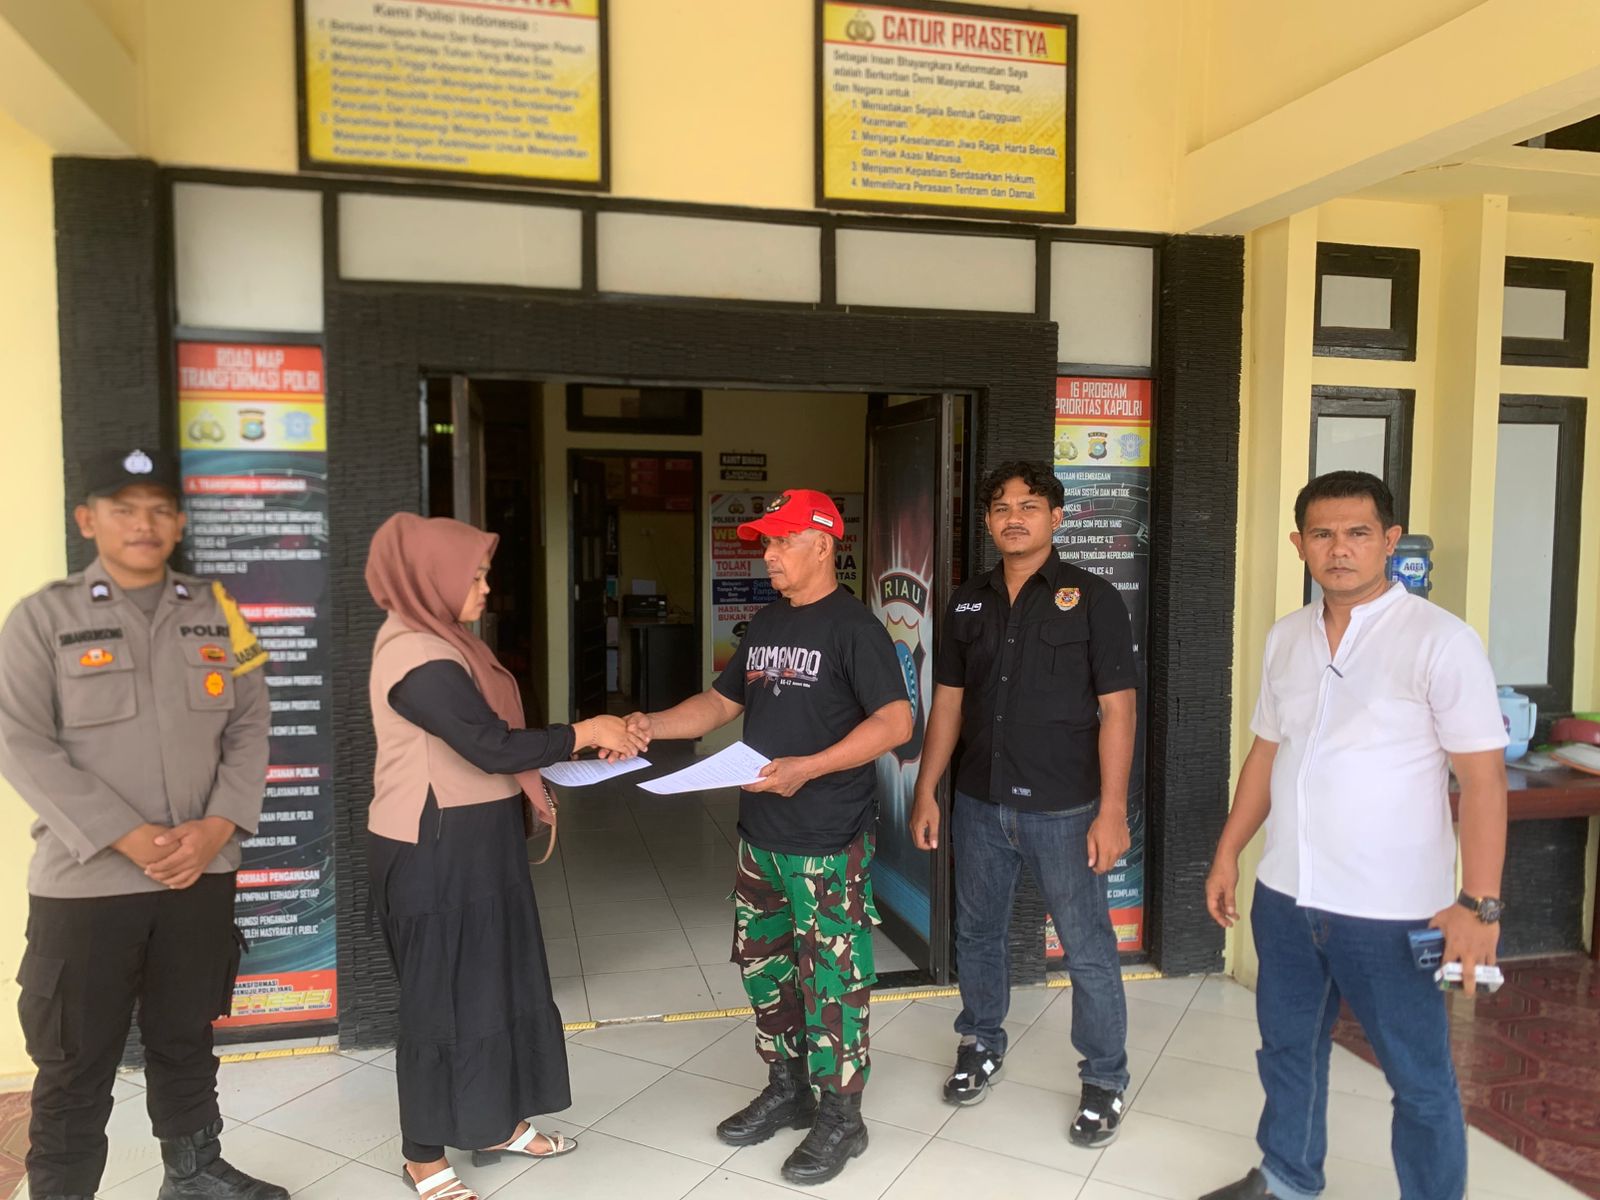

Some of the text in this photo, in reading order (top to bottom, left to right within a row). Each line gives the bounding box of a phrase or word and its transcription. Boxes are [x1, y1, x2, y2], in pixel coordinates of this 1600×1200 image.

[374, 4, 529, 31] Kami Polisi Indonesia
[883, 15, 1048, 57] CATUR PRASETYA
[834, 49, 868, 64] Sebagai
[1008, 66, 1029, 80] Saya
[833, 81, 850, 92] dan
[853, 83, 884, 96] Negara
[979, 110, 1022, 125] Gangguan
[950, 168, 1003, 181] Berdasarkan
[1070, 381, 1127, 401] 16 PROGRAM
[1056, 398, 1142, 417] PRIORITAS KAPOLRI
[884, 581, 921, 604] RIAU
[746, 646, 822, 676] KOMANDO
[269, 869, 321, 883] PENGAWASAN
[270, 889, 300, 902] TERHADAP
[300, 888, 321, 900] SETIAP
[260, 913, 298, 926] PENGAWASAN
[244, 927, 260, 939] OLEH
[299, 924, 319, 936] PUBLIC
